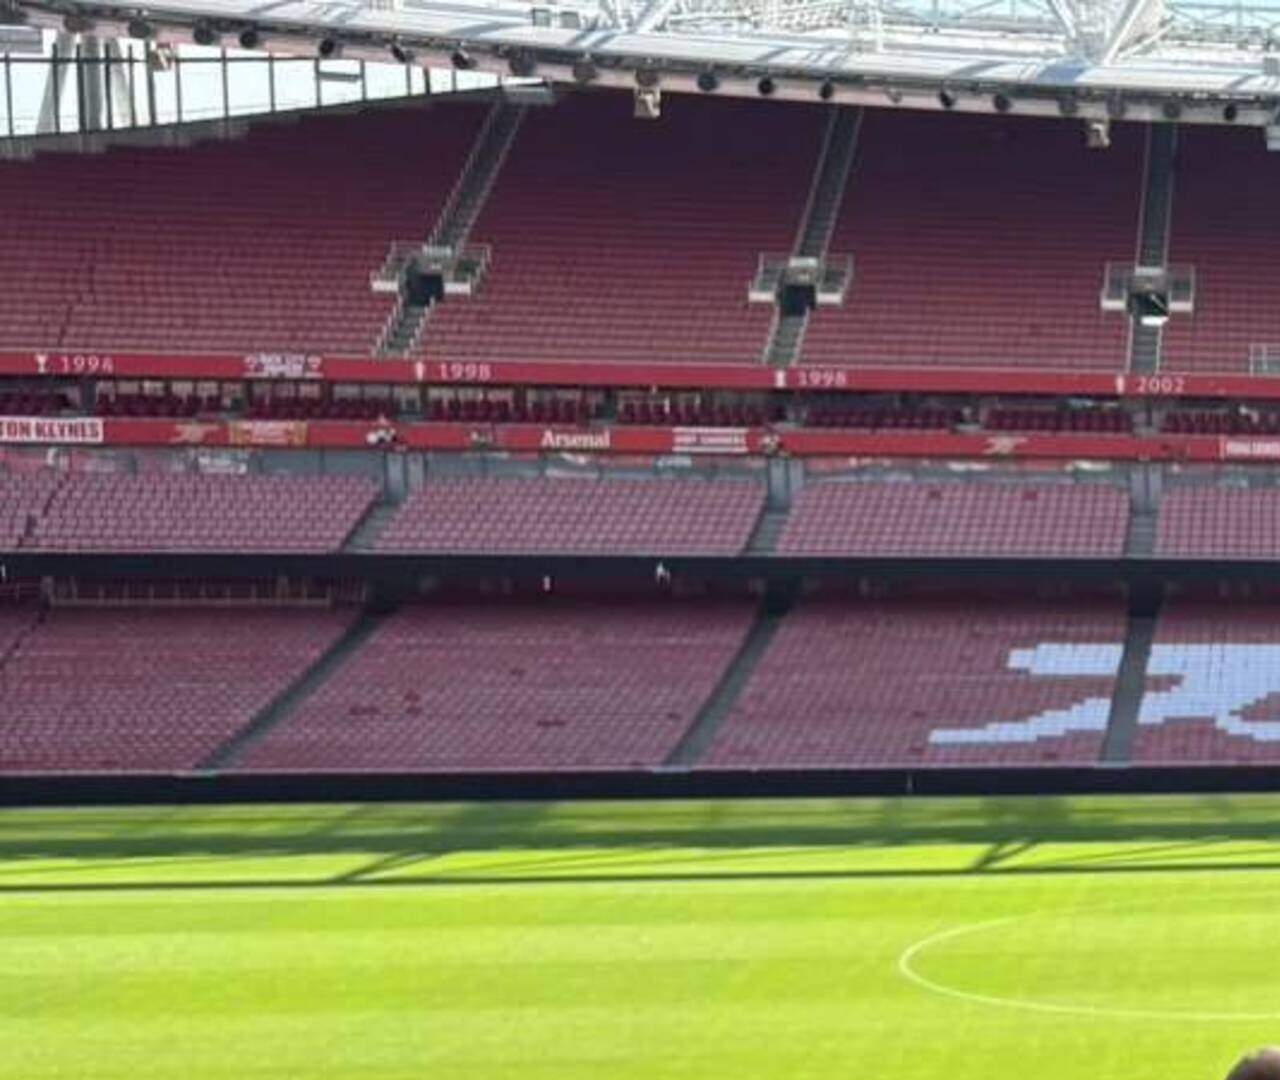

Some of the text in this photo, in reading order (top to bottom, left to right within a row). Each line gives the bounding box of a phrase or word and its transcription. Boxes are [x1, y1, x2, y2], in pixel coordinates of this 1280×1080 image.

[440, 363, 492, 380] 1998
[798, 370, 847, 386] 1998
[1136, 375, 1185, 393] 2002
[35, 421, 100, 438] KEYNES
[540, 429, 611, 448] Arsenal
